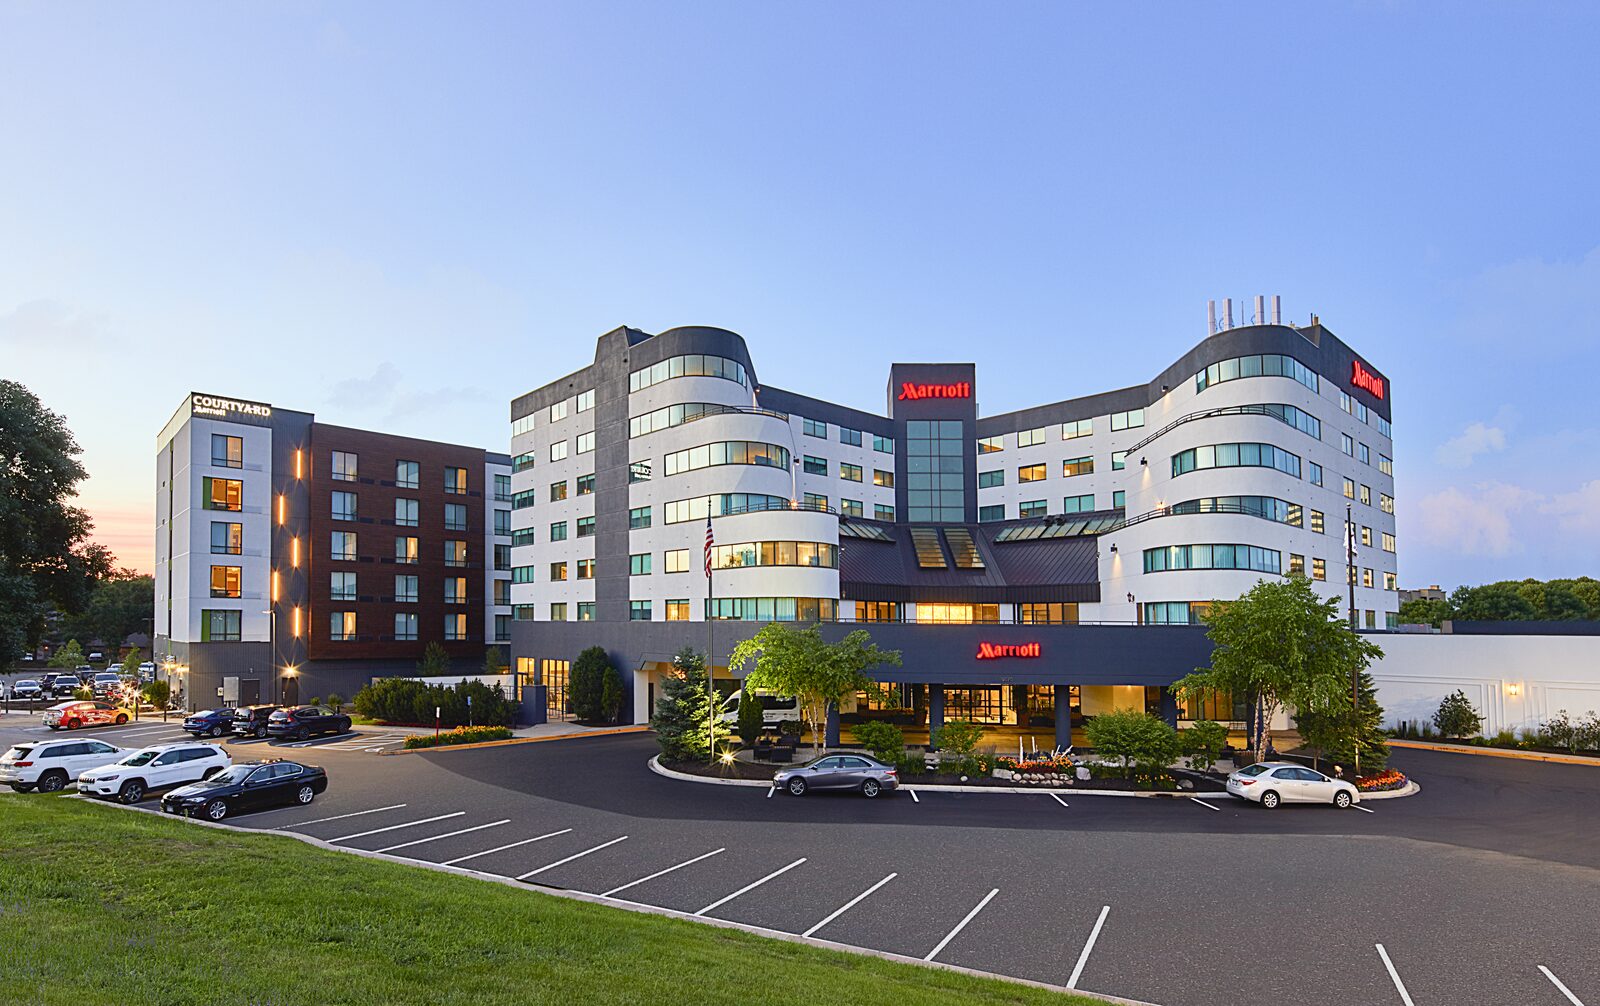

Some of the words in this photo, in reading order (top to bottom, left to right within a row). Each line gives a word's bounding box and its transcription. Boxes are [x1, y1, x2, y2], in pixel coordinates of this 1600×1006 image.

[1352, 360, 1384, 400] Marriott
[898, 382, 969, 400] Marriott
[192, 395, 272, 417] COURTYARD
[976, 642, 1040, 659] Marriott
